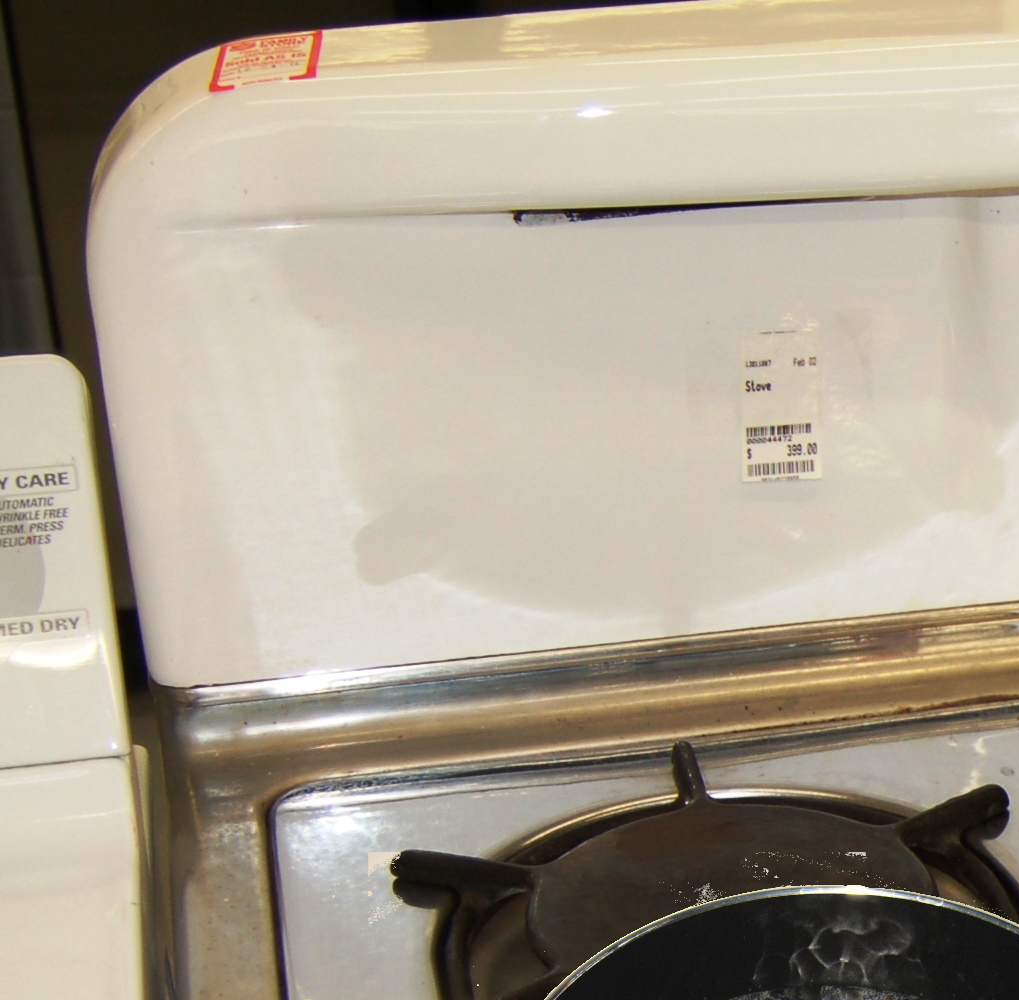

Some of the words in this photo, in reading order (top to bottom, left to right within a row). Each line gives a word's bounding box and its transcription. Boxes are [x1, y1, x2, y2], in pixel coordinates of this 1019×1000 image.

[745, 380, 772, 392] Stove
[746, 448, 752, 459] $
[786, 443, 818, 456] 399.00
[16, 472, 70, 489] CARE
[43, 507, 69, 519] FREE
[29, 520, 65, 533] PRESS
[0, 534, 52, 548] ELICATES
[40, 616, 80, 633] DRY
